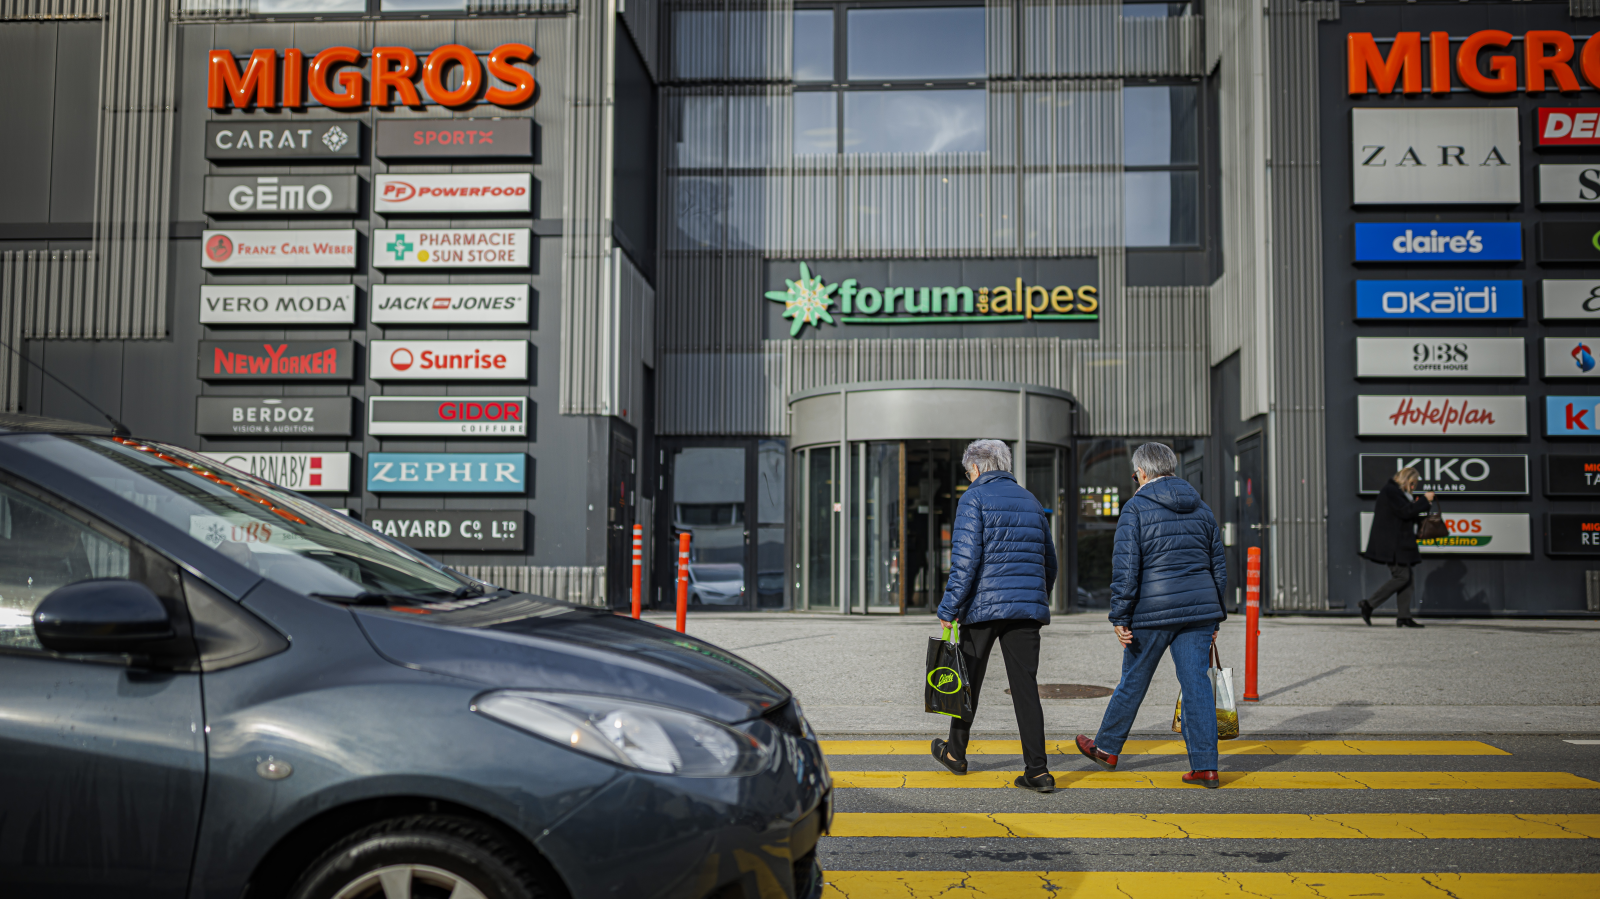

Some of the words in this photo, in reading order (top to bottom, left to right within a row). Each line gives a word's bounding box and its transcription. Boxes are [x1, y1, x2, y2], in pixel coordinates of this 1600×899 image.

[207, 43, 536, 109] MIGROS
[1543, 113, 1600, 138] DE
[215, 129, 312, 149] CARAT
[413, 130, 494, 145] SPORTX
[1361, 145, 1511, 167] ZARA
[418, 186, 526, 197] POWERFOOD
[419, 233, 516, 246] PHARMACIE
[1392, 229, 1483, 254] claire's
[432, 249, 463, 262] SUN
[467, 249, 516, 262] STORE
[206, 296, 269, 312] VERO
[275, 296, 347, 312] MODA
[378, 297, 431, 310] JACK
[451, 297, 516, 310] JONES
[838, 278, 974, 314] forum
[976, 286, 989, 313] des
[990, 277, 1098, 319] alpes
[419, 349, 507, 369] Sunrise
[1413, 363, 1442, 371] COFFEE
[1443, 363, 1469, 371] HOUSE
[232, 407, 314, 422] BERDOZ
[438, 402, 520, 421] GIDOR
[1389, 397, 1496, 433] Hotelplan
[232, 425, 261, 433] VISION
[264, 425, 270, 433] &
[272, 425, 314, 433] AUDITION
[461, 424, 524, 433] COIFFURE
[222, 455, 307, 488] ARNABY
[371, 462, 520, 483] ZEPHIR
[230, 521, 272, 543] UBS
[371, 519, 452, 538] BAYARD
